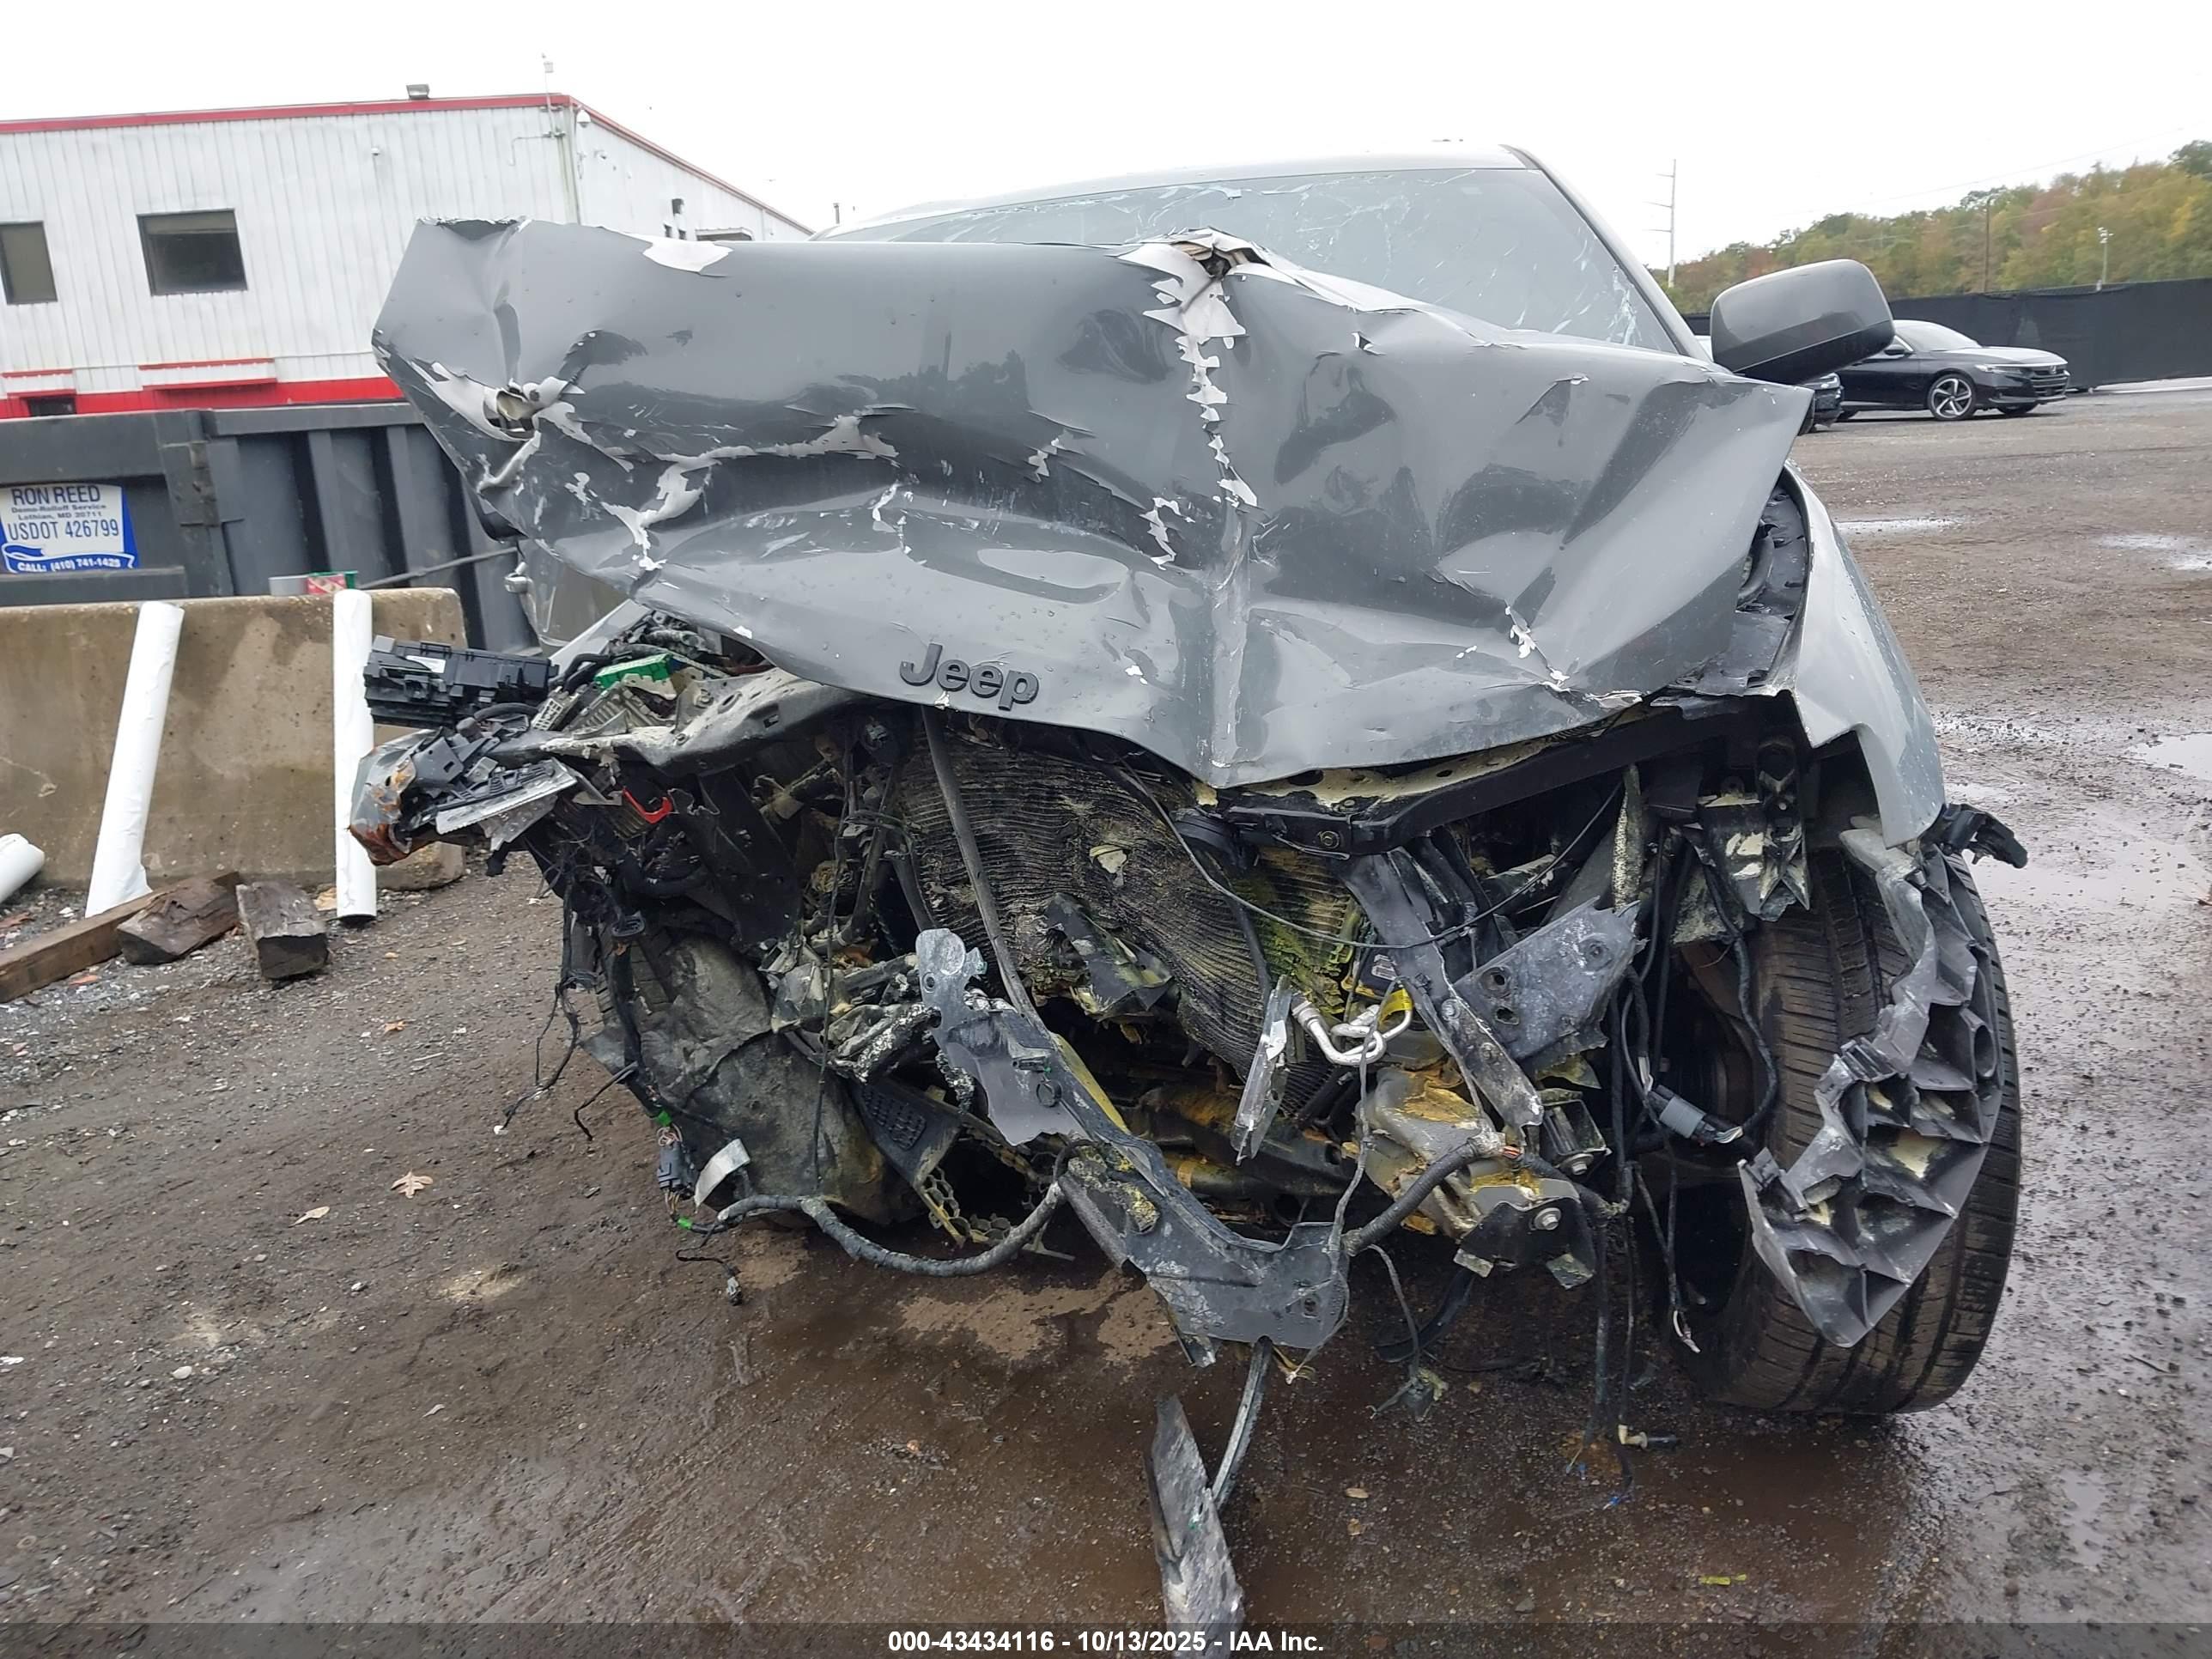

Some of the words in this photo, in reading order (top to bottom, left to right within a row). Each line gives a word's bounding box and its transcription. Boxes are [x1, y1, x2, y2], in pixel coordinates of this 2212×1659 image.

[11, 488, 49, 505] RON
[53, 484, 100, 503] REED
[8, 521, 58, 540] USDOT
[65, 519, 118, 538] 426799
[17, 562, 46, 572] CALL:
[50, 559, 76, 571] (410)
[899, 642, 1039, 711] Jeep
